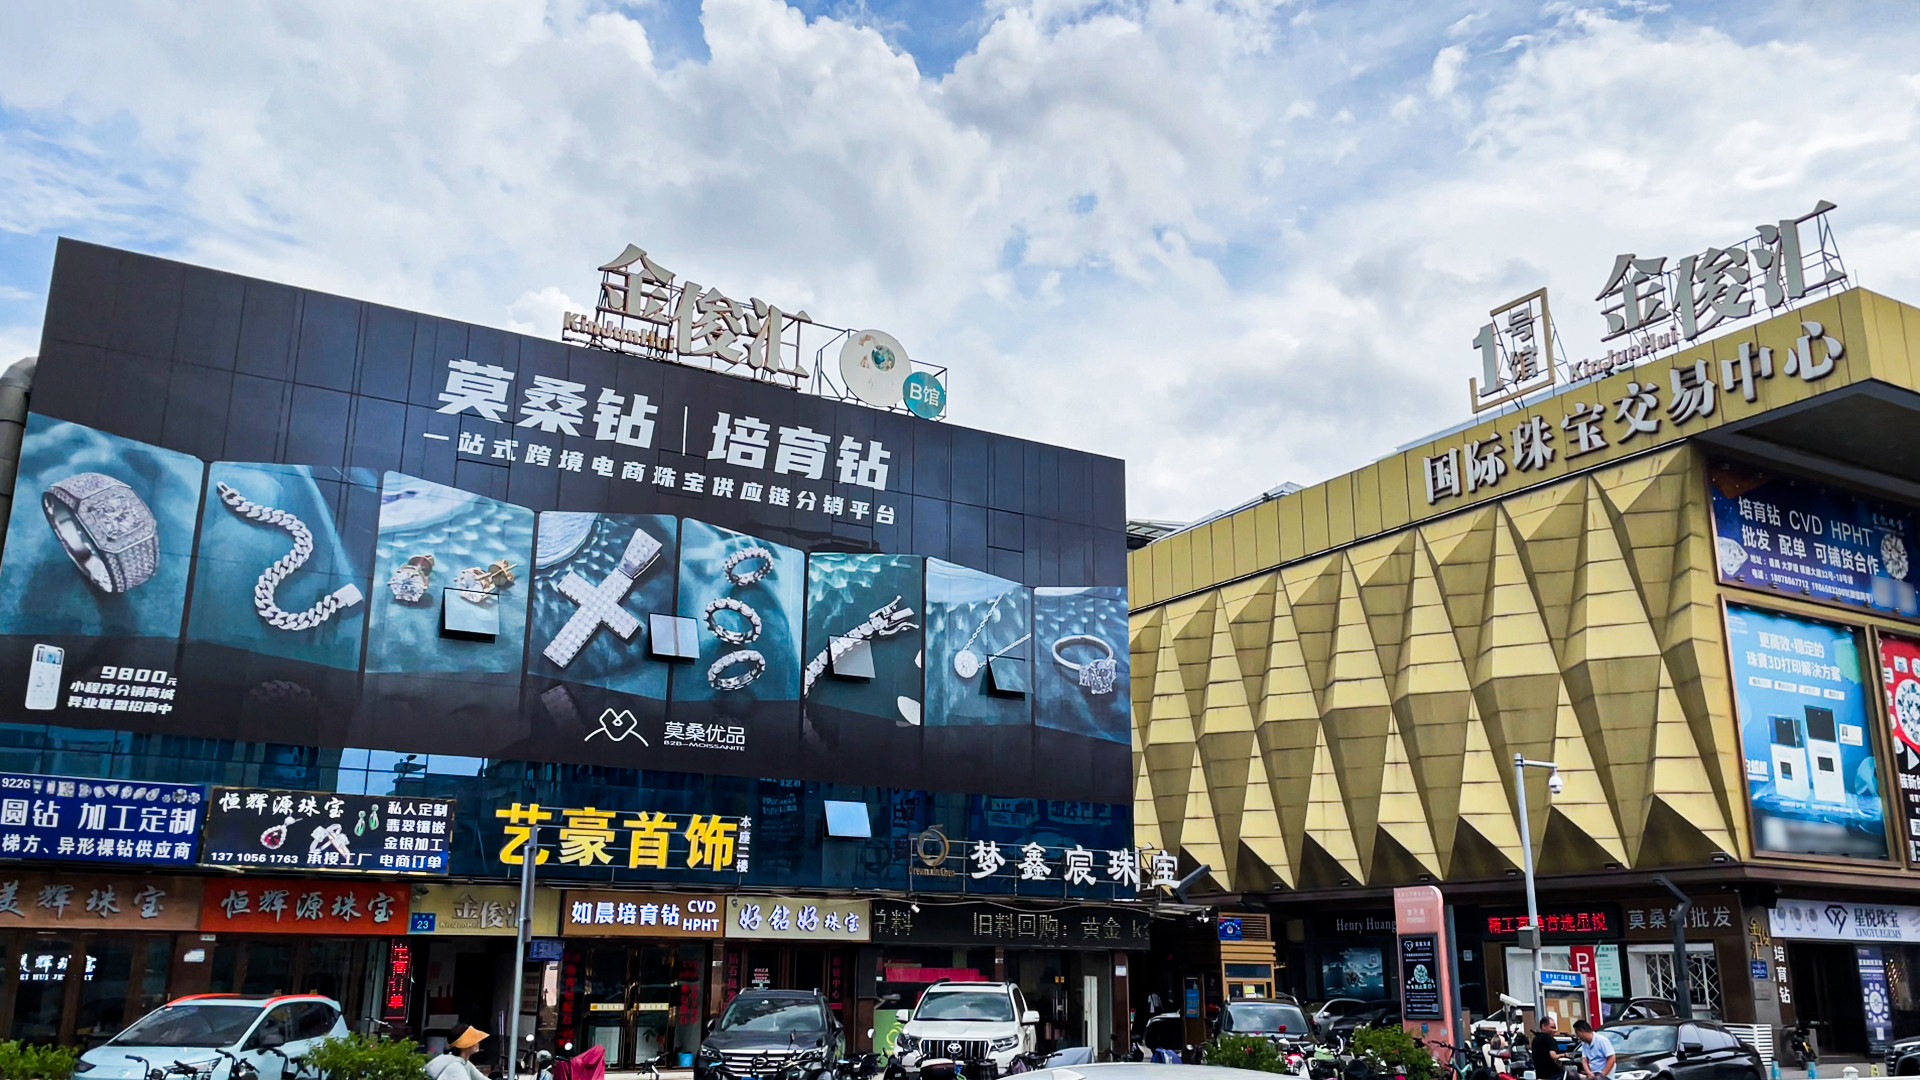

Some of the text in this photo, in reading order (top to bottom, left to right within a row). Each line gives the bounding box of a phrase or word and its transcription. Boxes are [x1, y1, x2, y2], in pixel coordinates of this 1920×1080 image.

[1595, 200, 1847, 342] 金俊汇
[596, 242, 813, 380] 金俊汇
[563, 310, 675, 354] KinJunHui
[1569, 325, 1679, 383] KinJunHui
[909, 381, 941, 408] B馆
[435, 358, 892, 491] 莫桑钻 培育钻
[1423, 320, 1845, 504] 国际珠宝交易中心
[423, 430, 897, 525] 一站式跨境电商珠宝供应链分销平台
[1738, 496, 1781, 527] 培育钻
[1789, 510, 1824, 535] CVD
[1830, 519, 1873, 547] HPHT
[1741, 525, 1772, 552] 批发
[1777, 533, 1807, 559] 配单
[1814, 542, 1880, 576] 可铺货合作
[100, 665, 178, 687] 9800元
[69, 680, 177, 701] 小程序分销商城
[67, 695, 173, 715] 异业联盟招商中
[664, 721, 746, 745] 莫桑优品
[0, 798, 197, 835] 圆钻 加工定制
[219, 791, 345, 819] 恒辉源珠宝
[387, 801, 448, 818] 私人定制
[386, 818, 446, 836] 翡翠镶嵌
[495, 803, 739, 872] 艺豪首饰
[2, 833, 192, 860] 梯方、异形裸钻供应商
[384, 836, 443, 852] 金银加工
[736, 815, 752, 873] 本座二楼
[211, 851, 373, 866] 137 1056 1763 承接工厂
[379, 854, 442, 869] 电商订单
[969, 839, 1181, 891] 梦鑫宸珠宝
[220, 888, 396, 924] 恒辉源珠宝
[571, 900, 680, 926] 如晨培育钻
[687, 900, 717, 914] CVD
[738, 903, 860, 933] 好钻好珠宝
[1854, 907, 1900, 928] 星悦珠宝
[417, 920, 429, 930] 23
[682, 918, 720, 932] HPHT
[1080, 915, 1121, 940] 黄金
[1336, 917, 1397, 934] Henry Huang
[1576, 952, 1589, 972] P
[1773, 945, 1791, 1004] 培育钻
